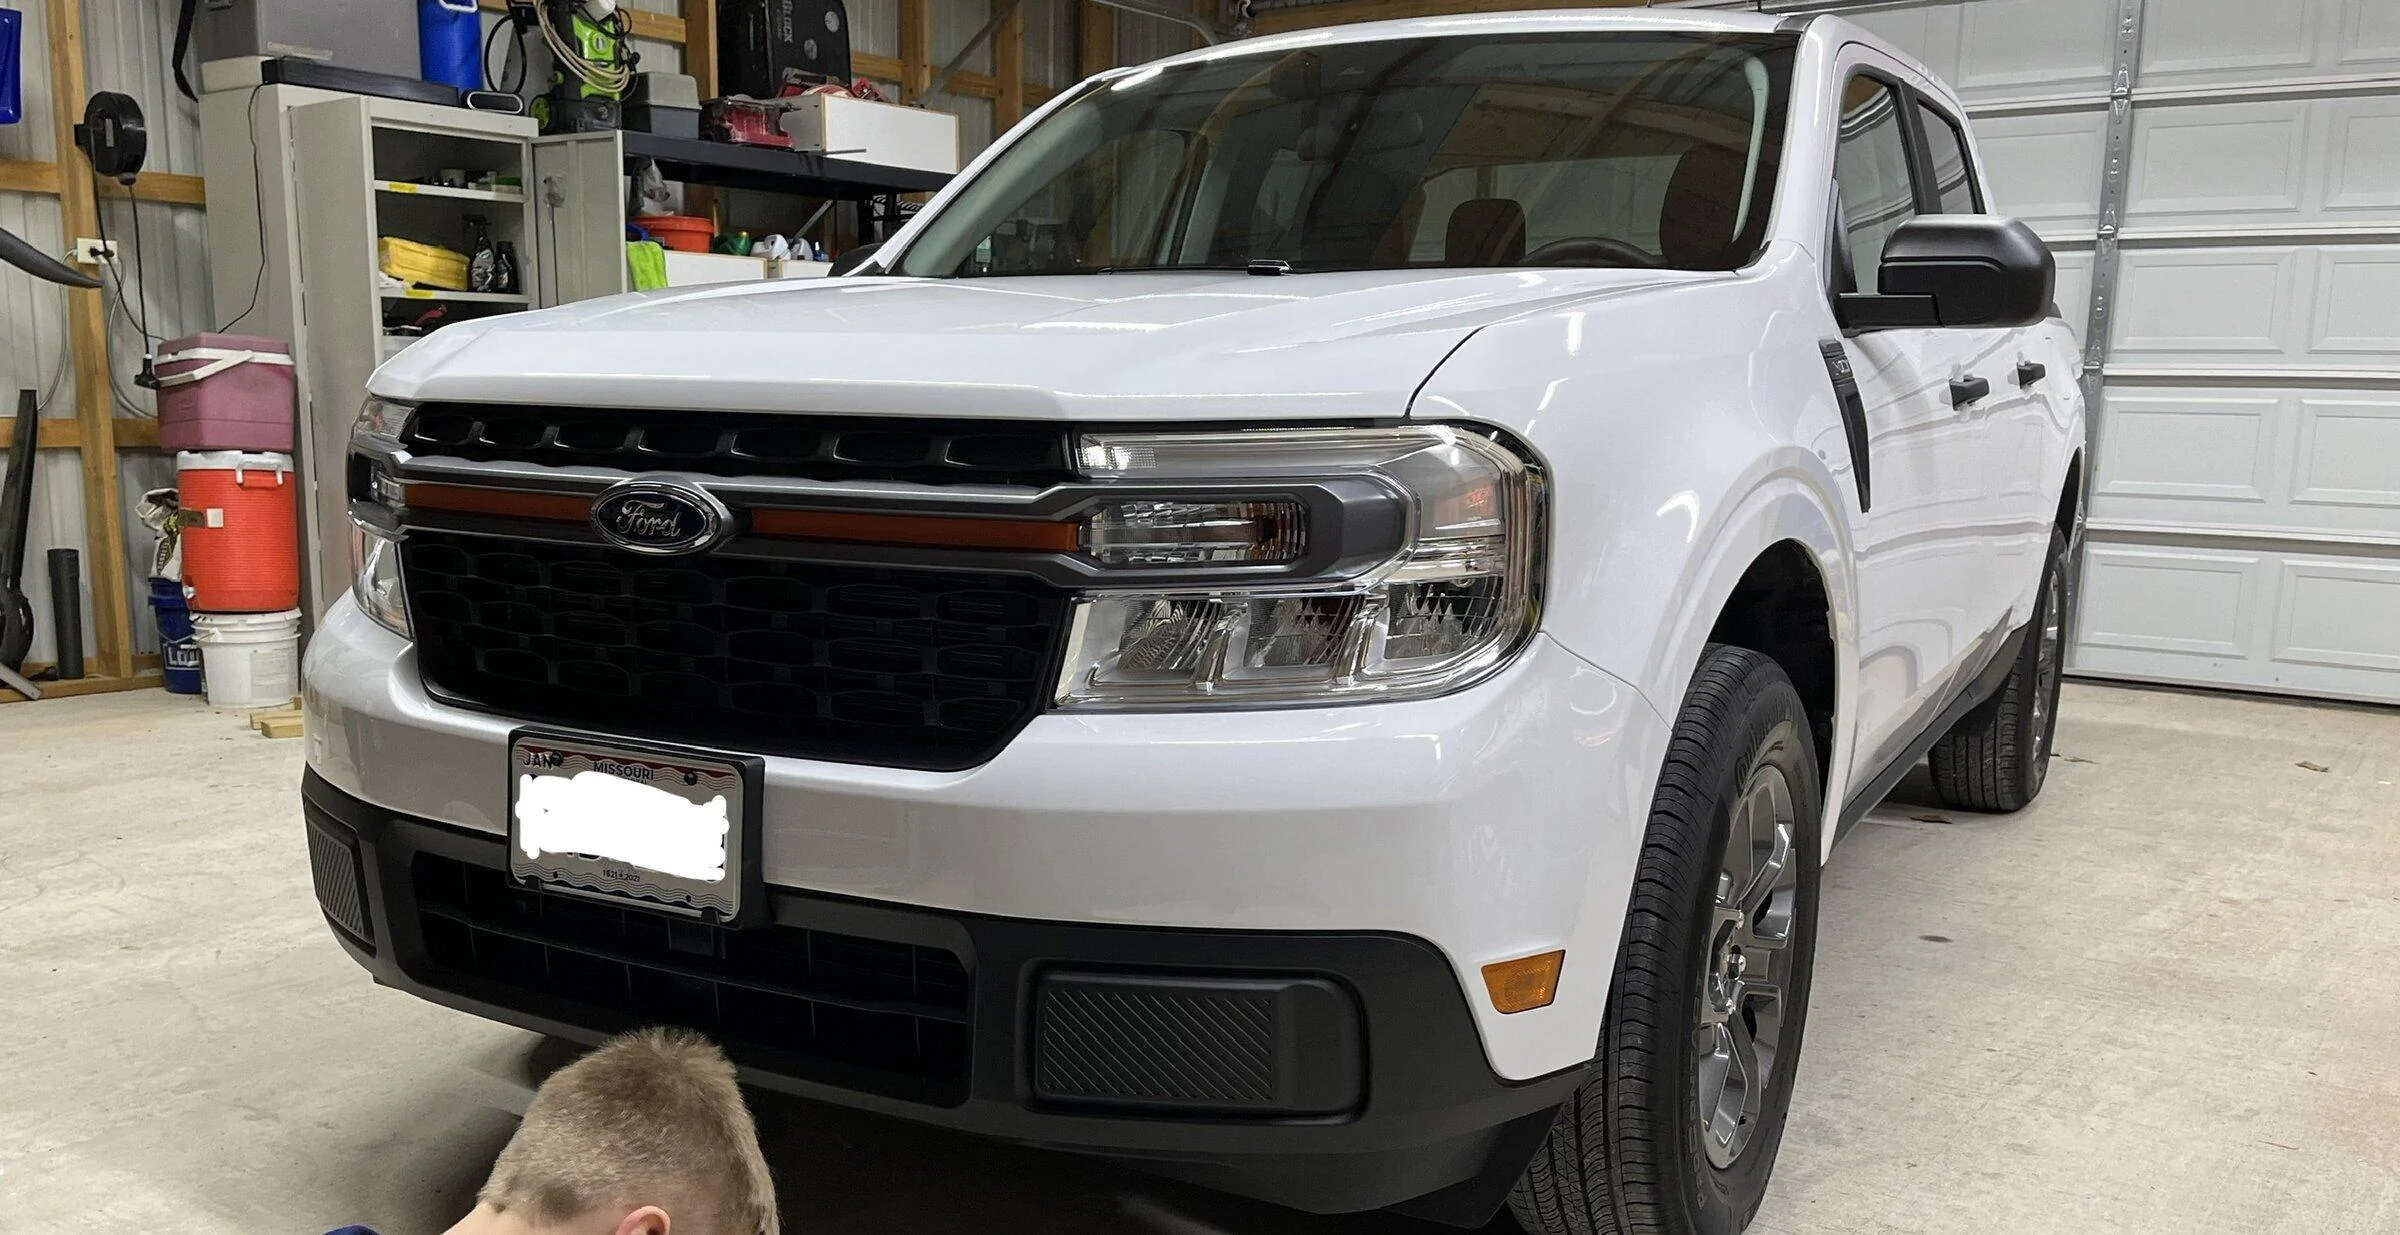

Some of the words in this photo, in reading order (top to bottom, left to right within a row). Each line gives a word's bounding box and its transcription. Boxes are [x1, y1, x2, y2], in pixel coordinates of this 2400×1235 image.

[616, 499, 682, 537] Ford
[523, 751, 552, 769] JAN
[593, 761, 654, 780] MISSOURI
